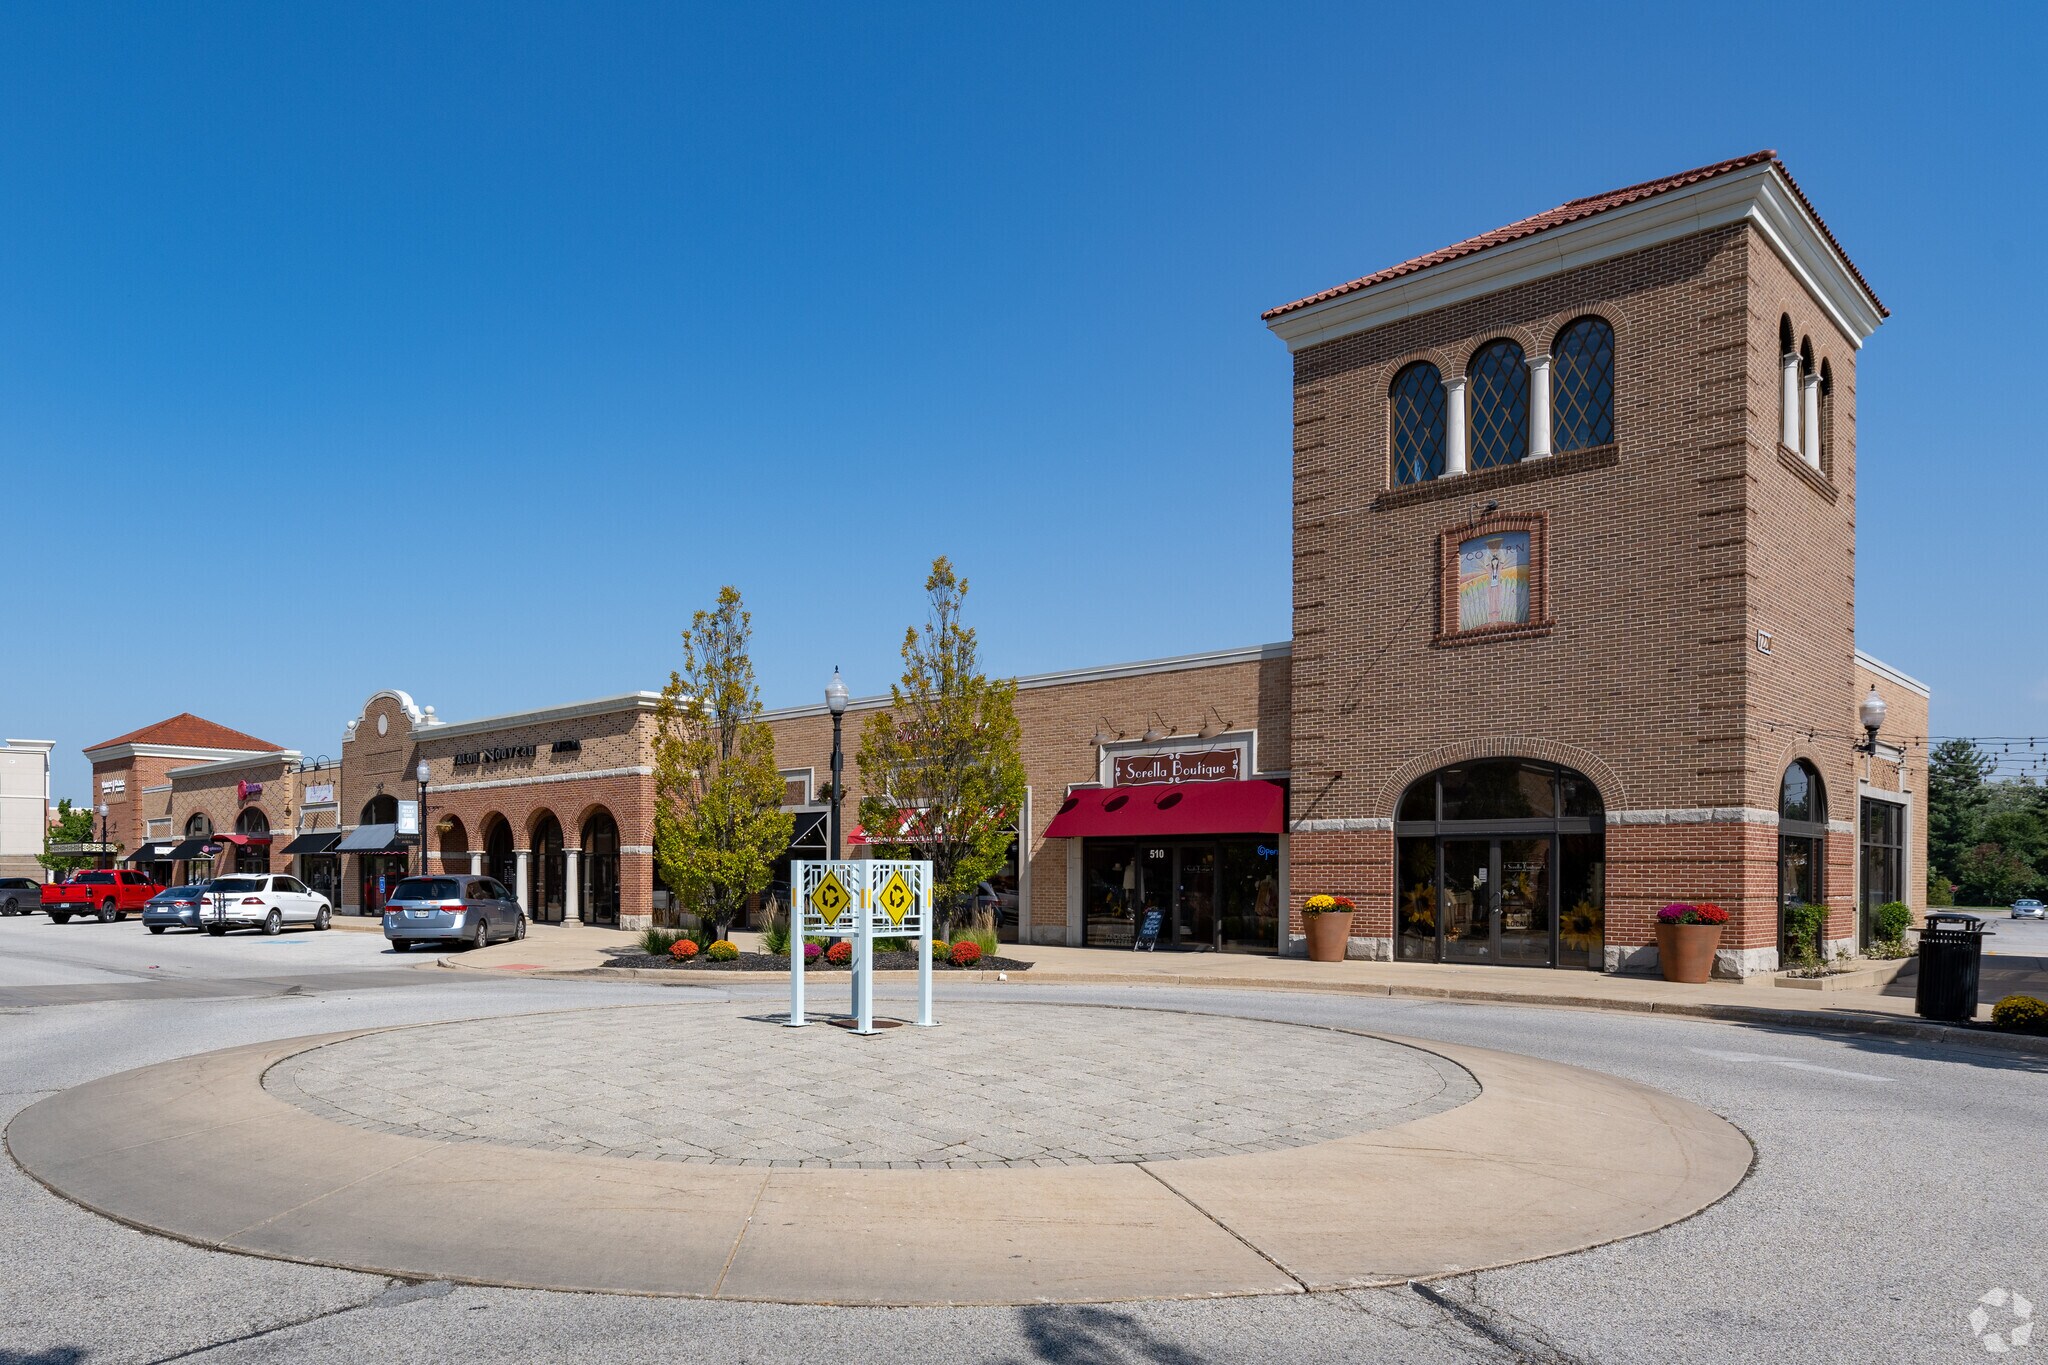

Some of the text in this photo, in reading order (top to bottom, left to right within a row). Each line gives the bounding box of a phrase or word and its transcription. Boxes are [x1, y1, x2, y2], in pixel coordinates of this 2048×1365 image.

[1126, 760, 1226, 779] Sorella Boutique
[1149, 849, 1165, 859] 510
